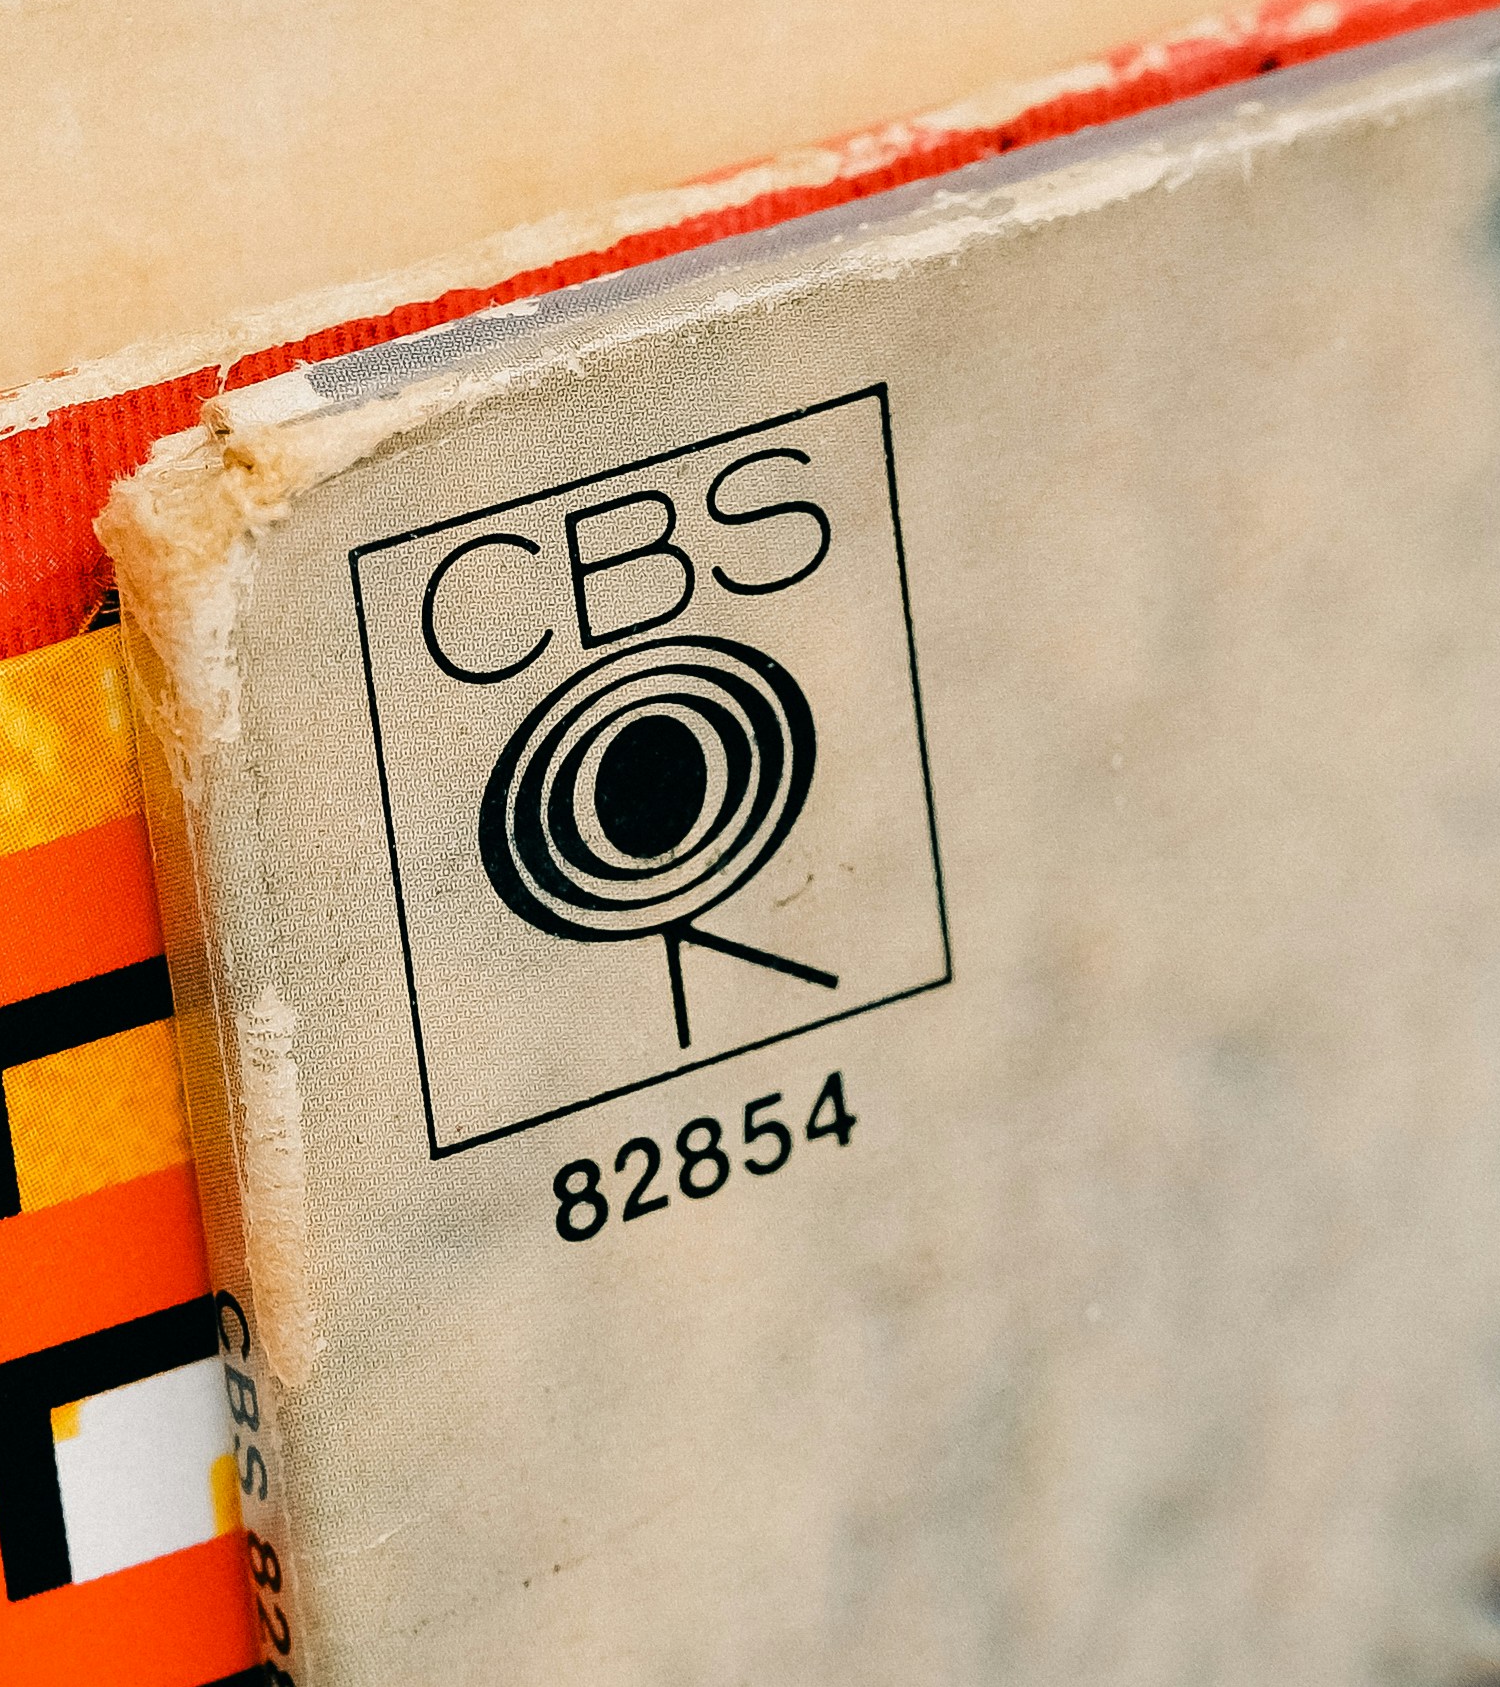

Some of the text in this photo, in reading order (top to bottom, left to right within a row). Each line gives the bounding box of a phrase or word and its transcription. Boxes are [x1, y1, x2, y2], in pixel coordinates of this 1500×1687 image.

[420, 446, 832, 685] CBS
[552, 1071, 858, 1244] 82854
[215, 1288, 269, 1502] CBS
